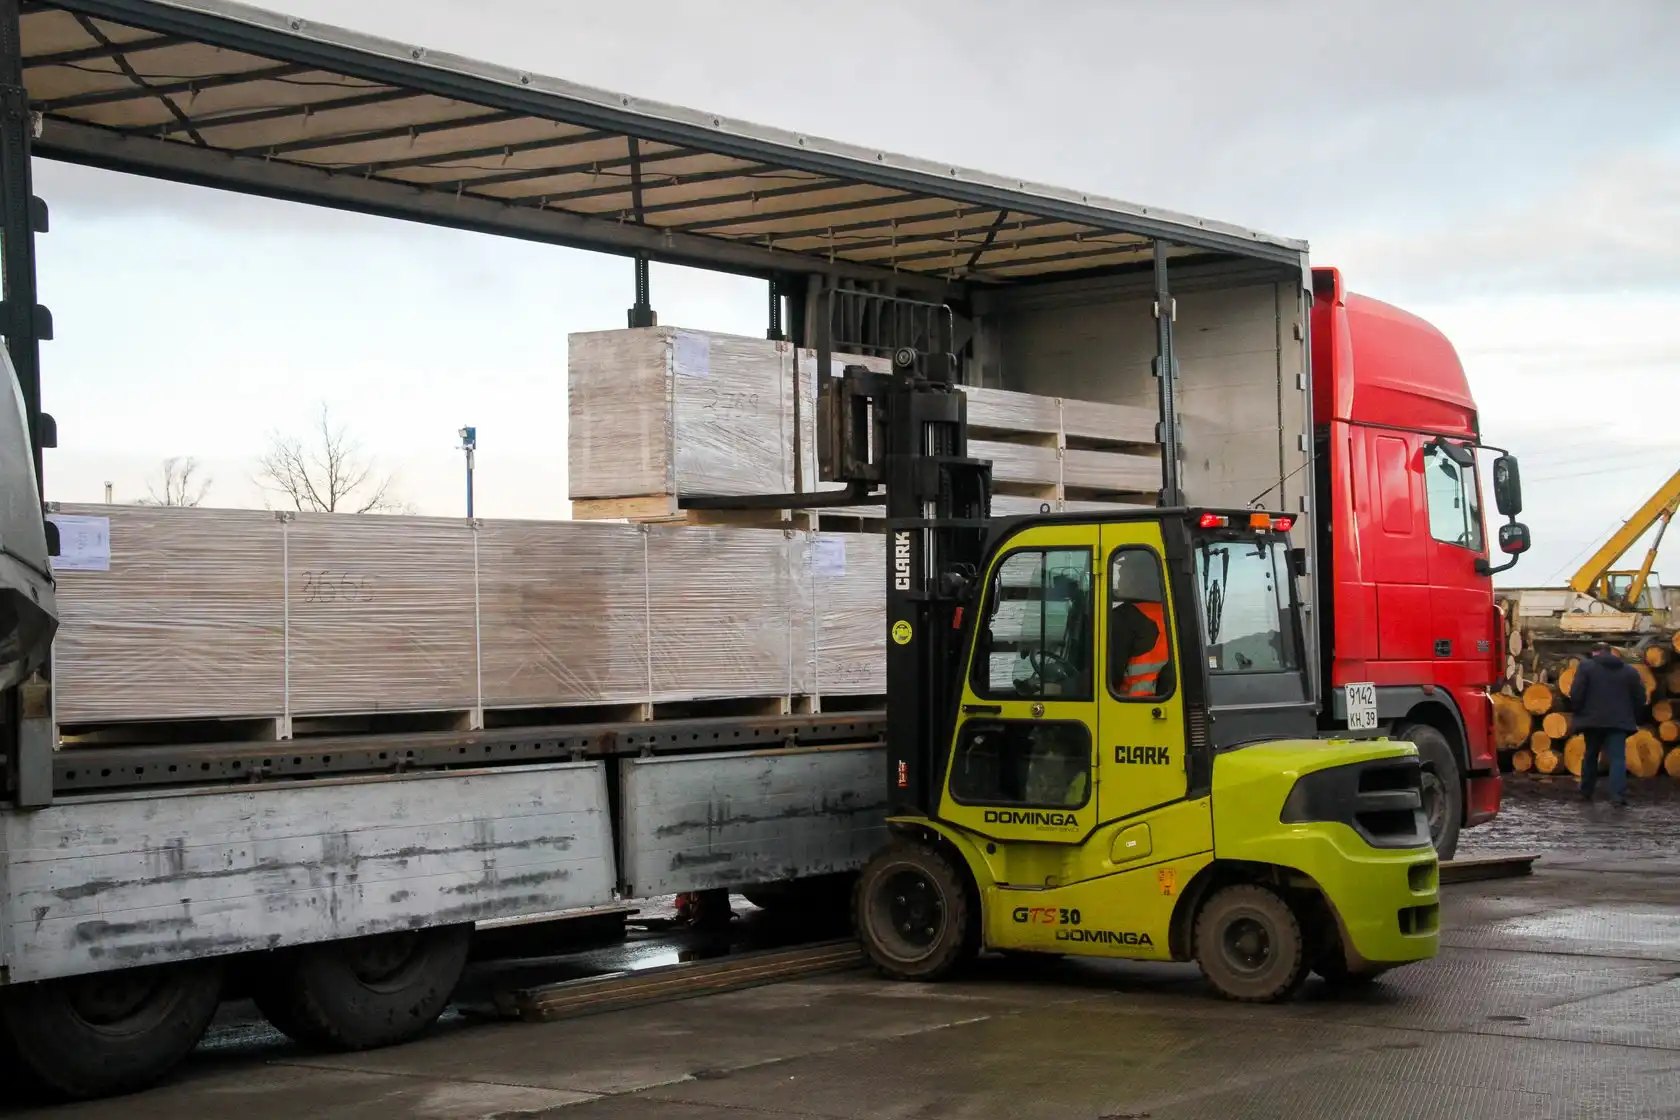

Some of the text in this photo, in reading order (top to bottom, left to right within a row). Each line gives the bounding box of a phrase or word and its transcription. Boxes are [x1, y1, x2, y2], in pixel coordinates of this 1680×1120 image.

[895, 531, 910, 590] CLARK
[1350, 686, 1373, 705] 9142
[1365, 711, 1376, 726] 39
[1115, 745, 1170, 765] CLARK
[984, 810, 1079, 827] DOMINGA
[1012, 907, 1081, 925] GTS 30
[1055, 928, 1153, 946] DOMINGA
